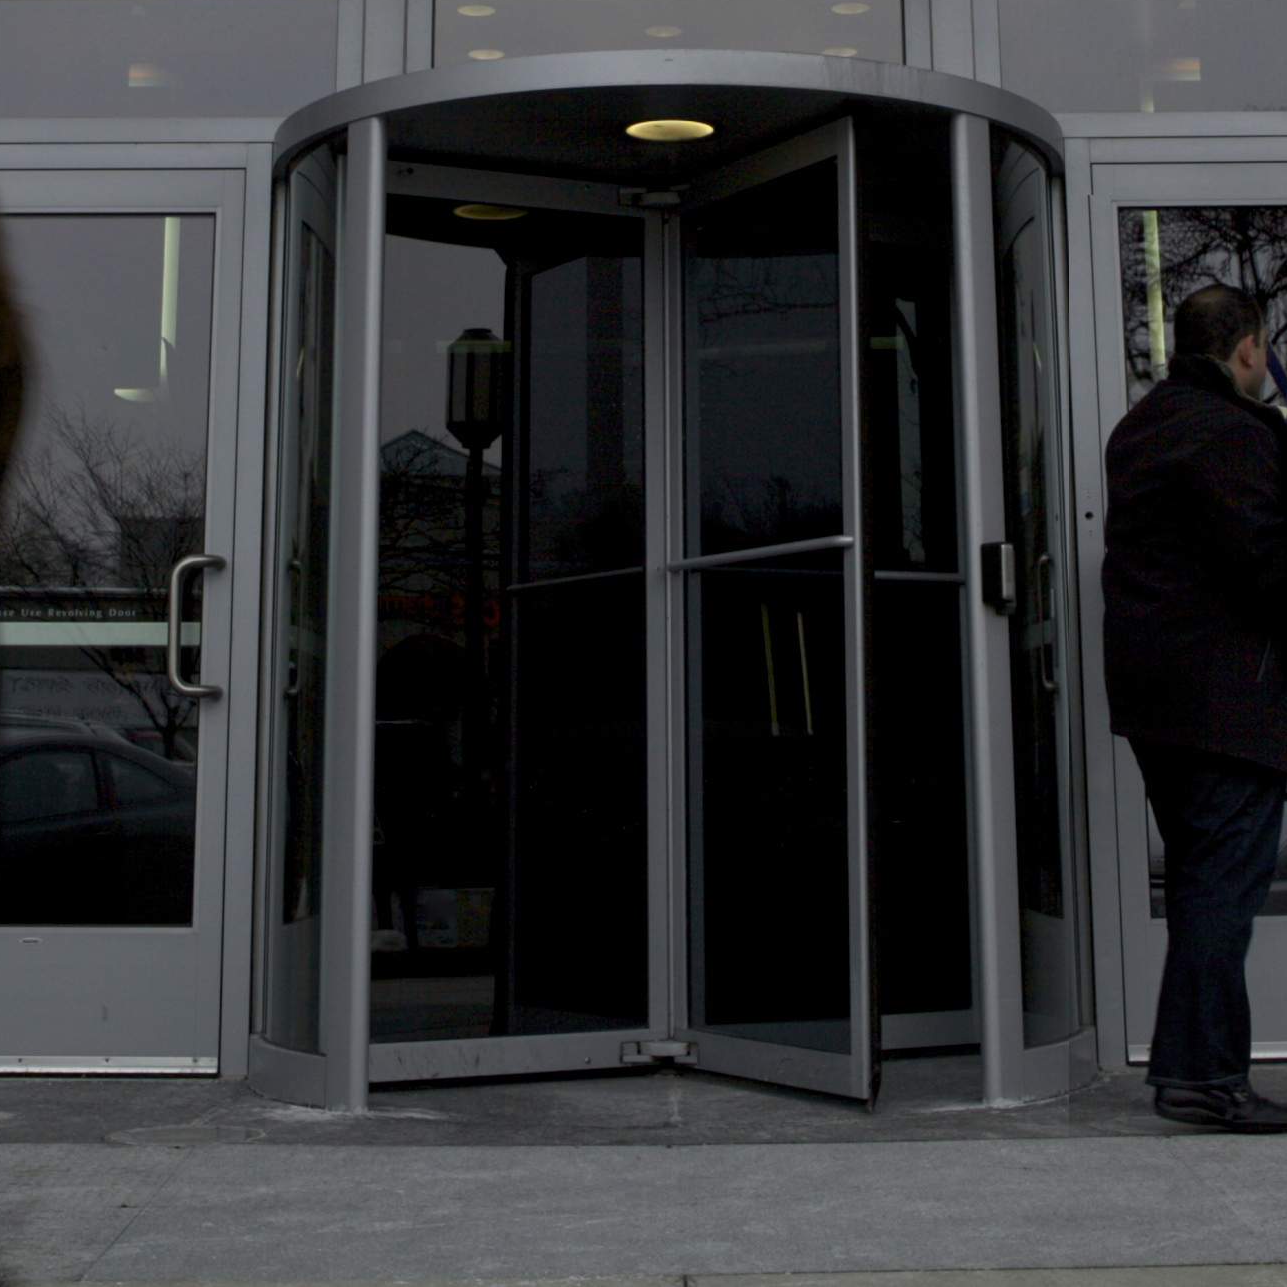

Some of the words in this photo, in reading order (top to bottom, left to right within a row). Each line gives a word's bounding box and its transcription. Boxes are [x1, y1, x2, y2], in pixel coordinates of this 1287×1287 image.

[21, 608, 42, 617] Use
[47, 608, 103, 619] Revolving
[108, 608, 136, 617] Door
